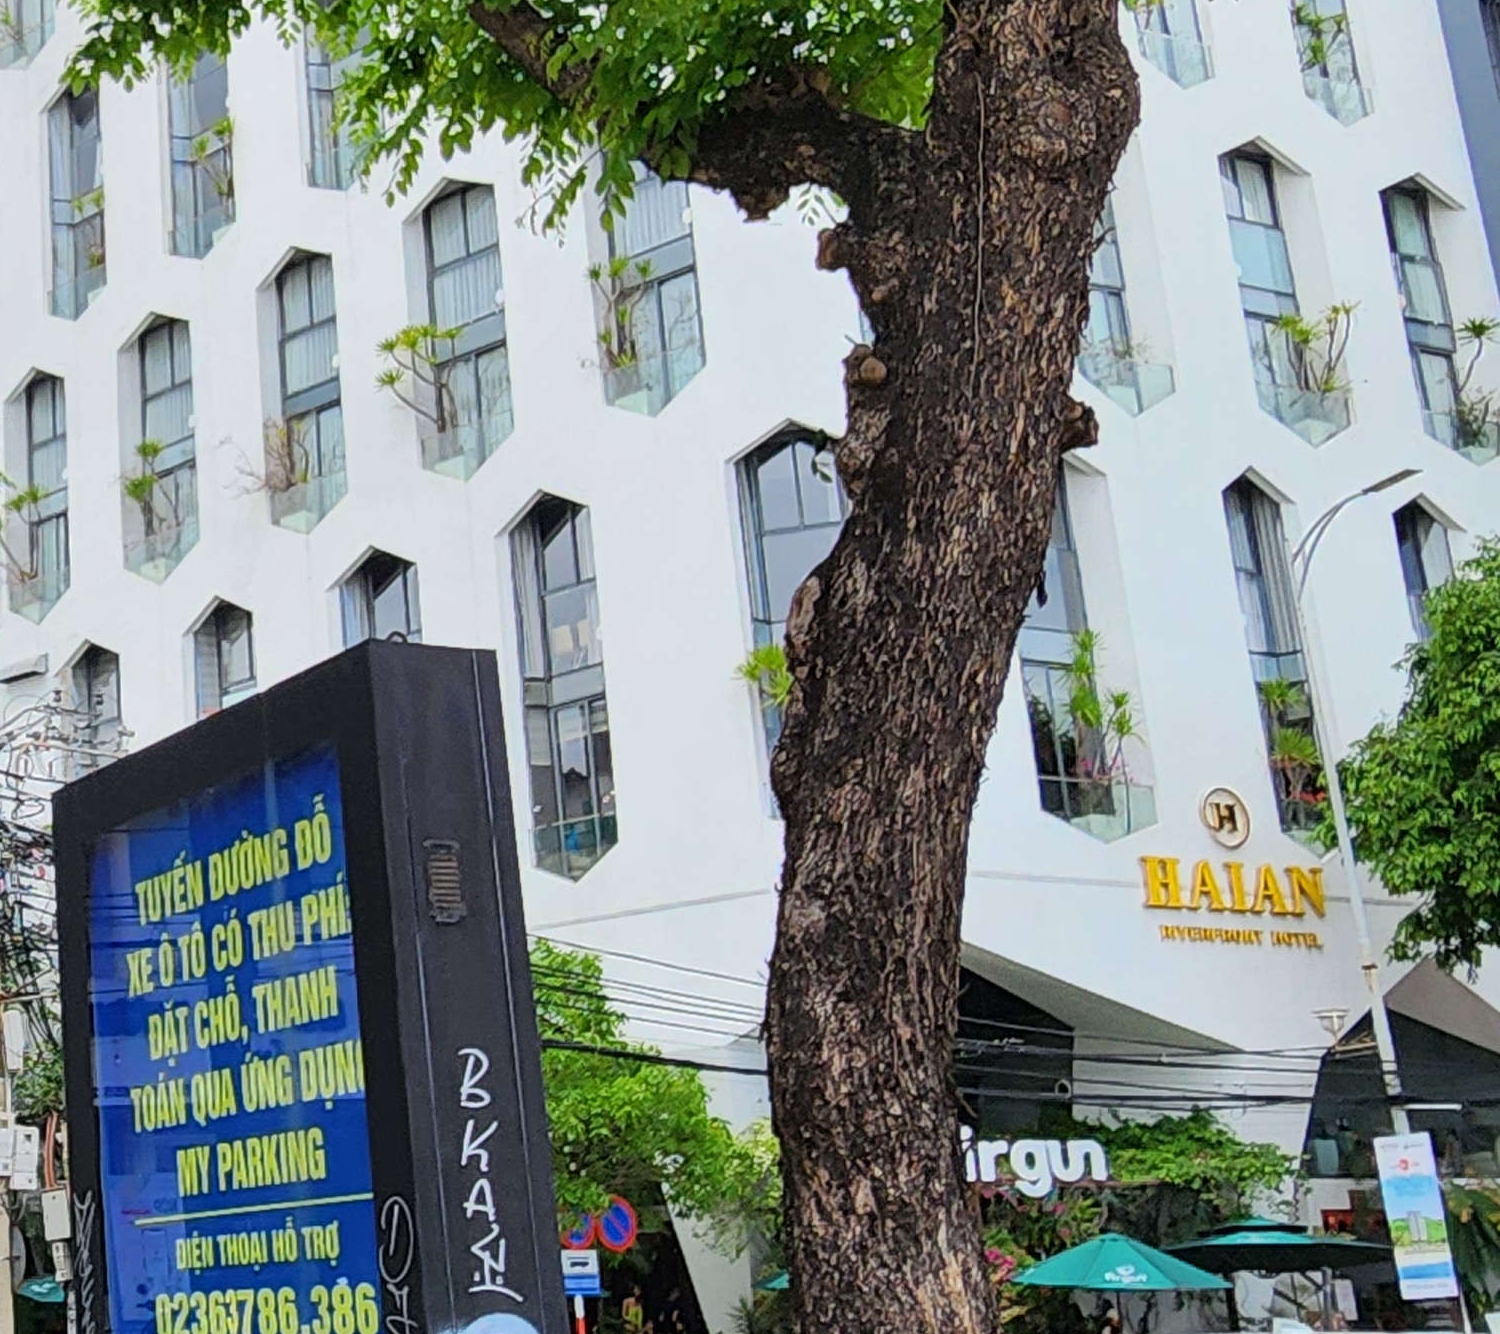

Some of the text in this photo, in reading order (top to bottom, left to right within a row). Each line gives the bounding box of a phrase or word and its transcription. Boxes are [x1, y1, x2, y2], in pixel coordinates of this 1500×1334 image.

[134, 793, 332, 927] TUYẾN ĐƯỜNG ĐỖ
[1138, 855, 1327, 919] HAIAN
[126, 947, 154, 998] XE
[158, 932, 174, 987] Ô
[178, 921, 206, 982] TÔ
[211, 908, 243, 972] CÓ
[247, 901, 296, 961] THU
[148, 965, 339, 1067] ĐẶT CHỖ, THANH
[130, 1072, 187, 1133] TOÁN
[191, 1067, 237, 1127] QUA
[240, 1052, 295, 1113] ỨNG
[176, 1127, 326, 1198] MY PARKING
[960, 1125, 1109, 1198] irgun
[216, 1230, 269, 1271] THOẠI
[271, 1216, 298, 1262] HỖ
[301, 1220, 340, 1267] TRỢ
